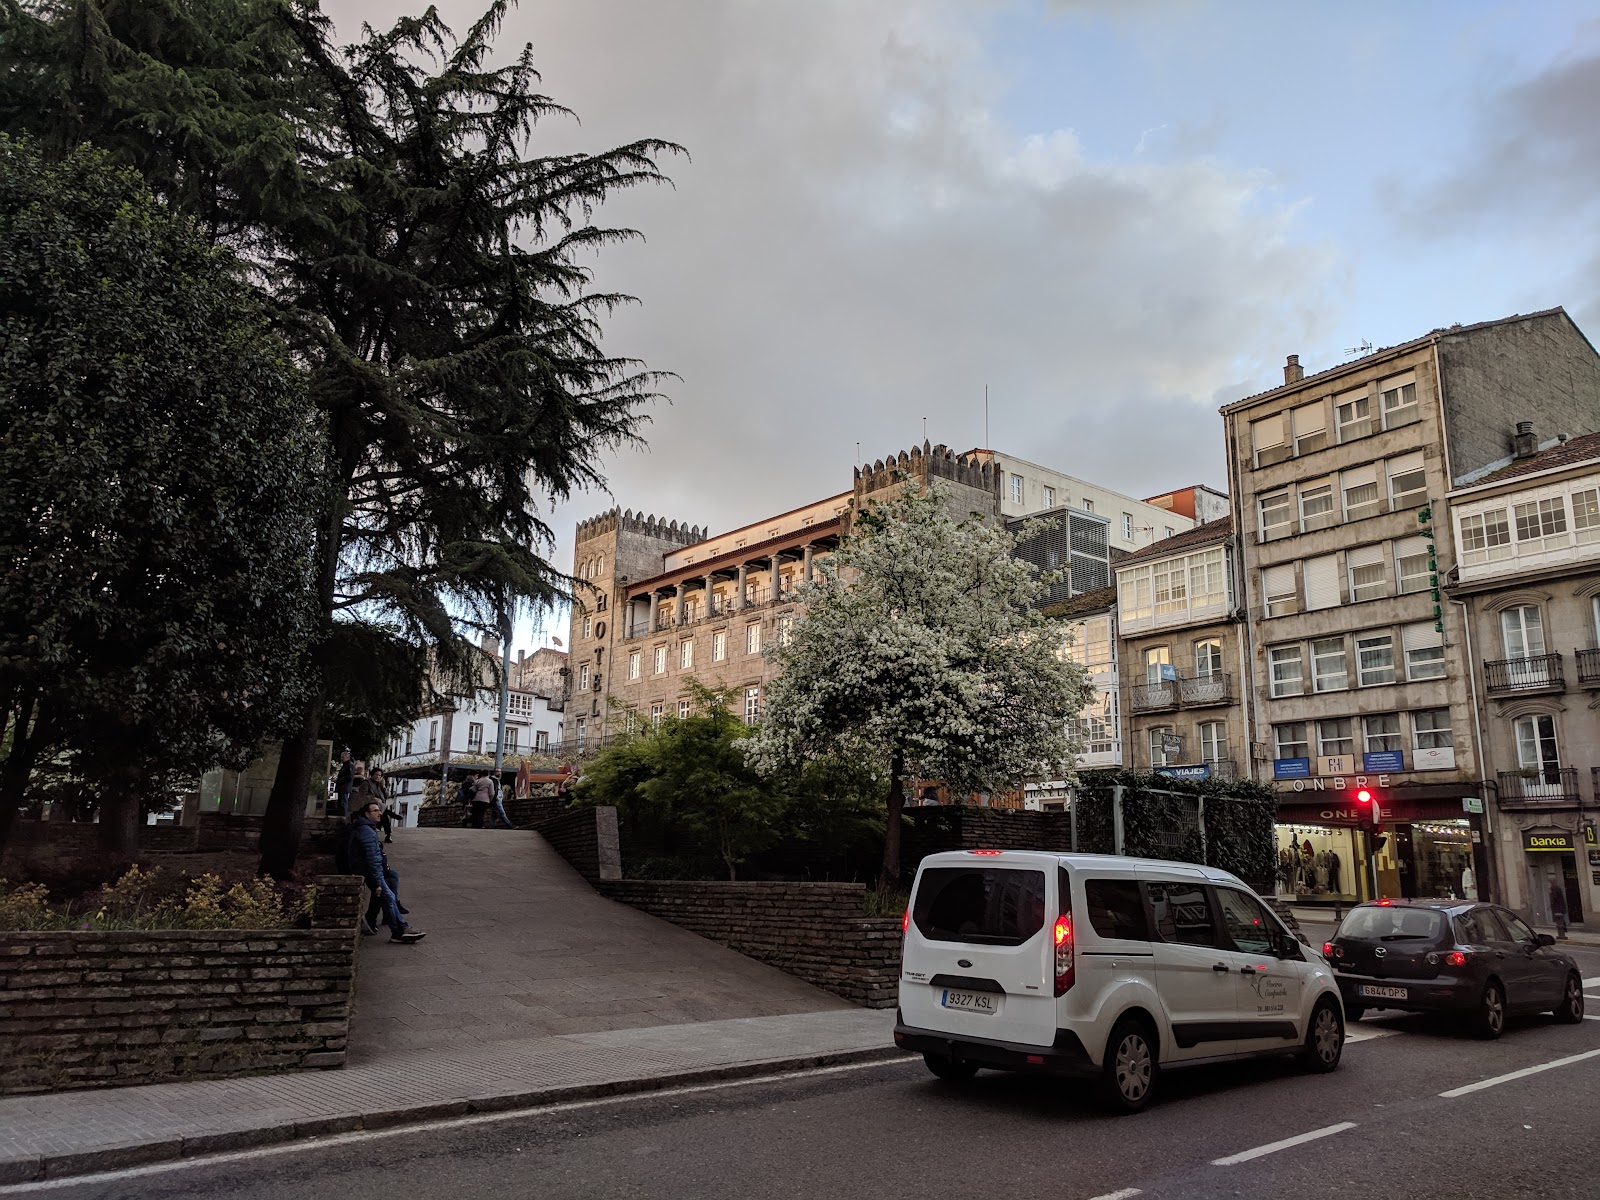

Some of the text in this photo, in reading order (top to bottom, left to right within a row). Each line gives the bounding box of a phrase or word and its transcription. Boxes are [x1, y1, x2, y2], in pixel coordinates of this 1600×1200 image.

[1175, 767, 1205, 776] VIAJES
[1293, 774, 1390, 792] ONBRE
[1530, 836, 1567, 846] Bankia
[1364, 986, 1406, 998] 6844 DPS
[949, 992, 973, 1006] 9327
[974, 995, 993, 1010] KSL
